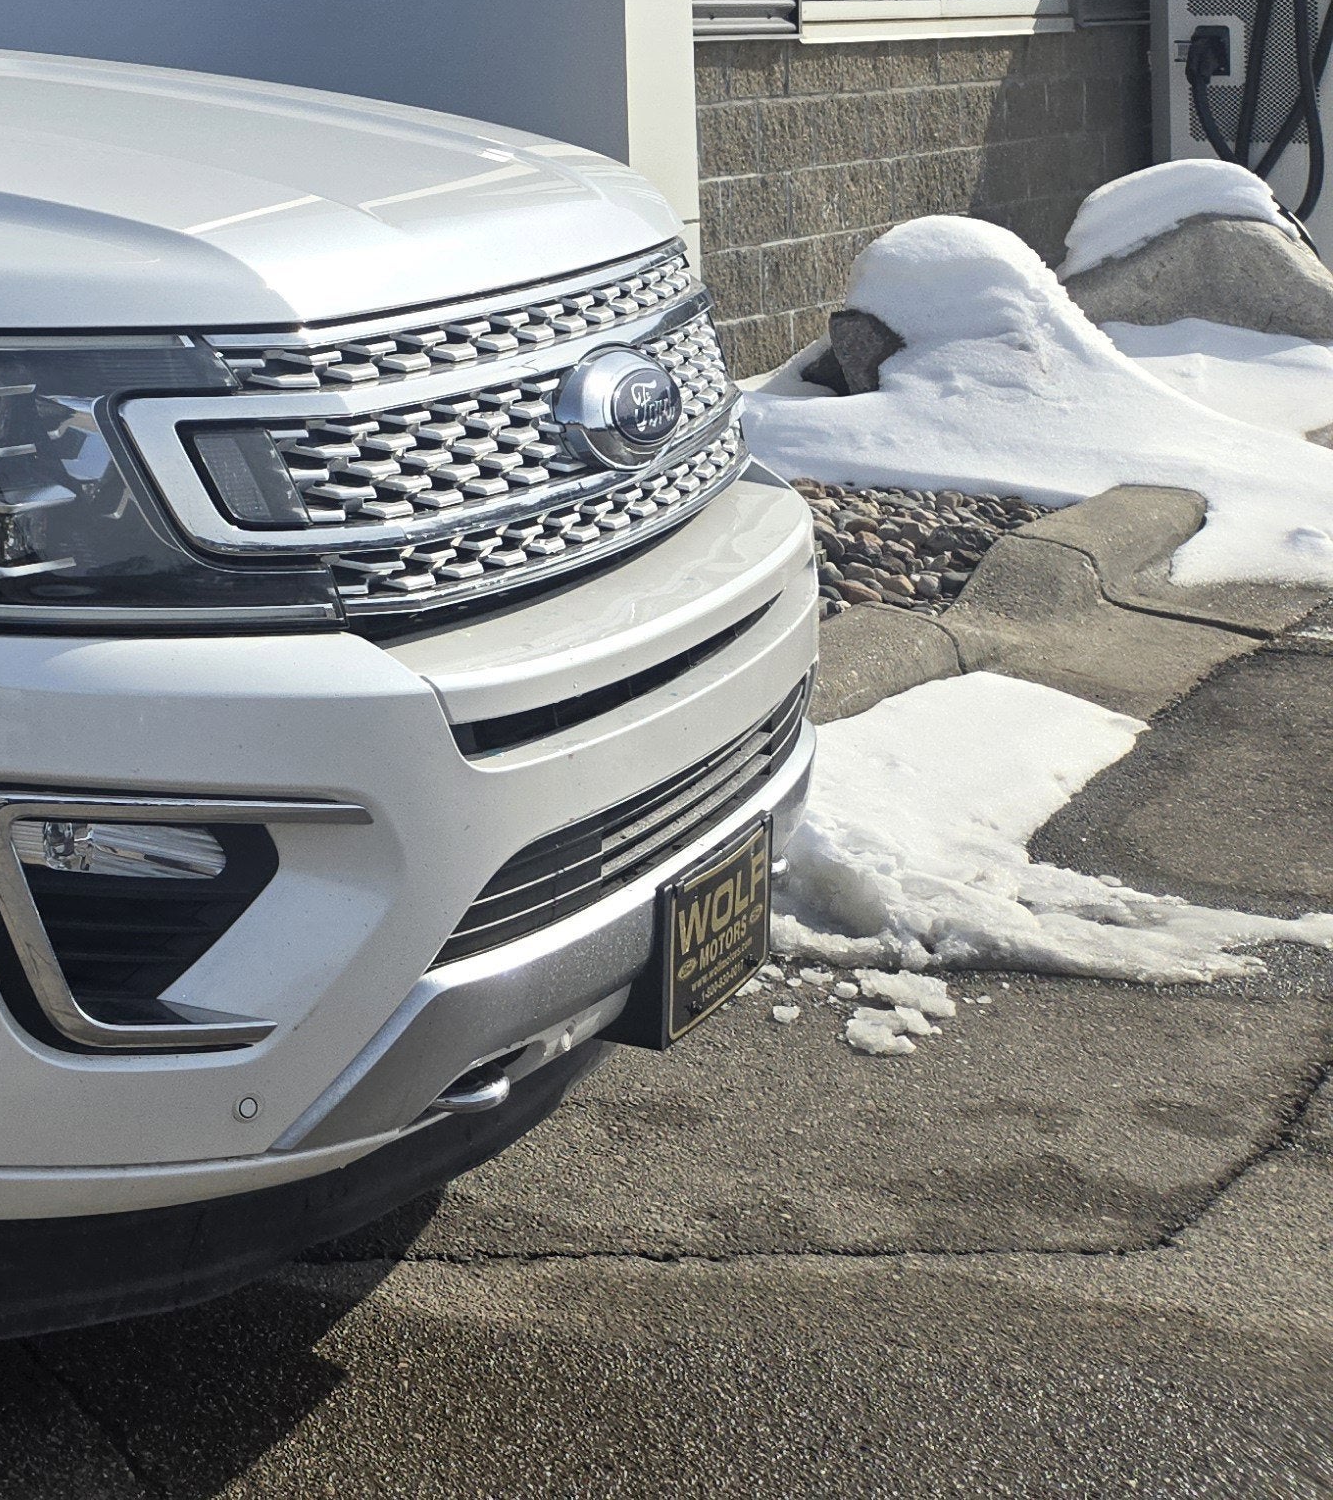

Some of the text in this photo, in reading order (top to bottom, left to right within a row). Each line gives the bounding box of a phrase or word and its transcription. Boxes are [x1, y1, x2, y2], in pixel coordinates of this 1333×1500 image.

[631, 380, 676, 432] Ford
[678, 849, 766, 956] WOLF
[699, 913, 748, 971] MOTORS
